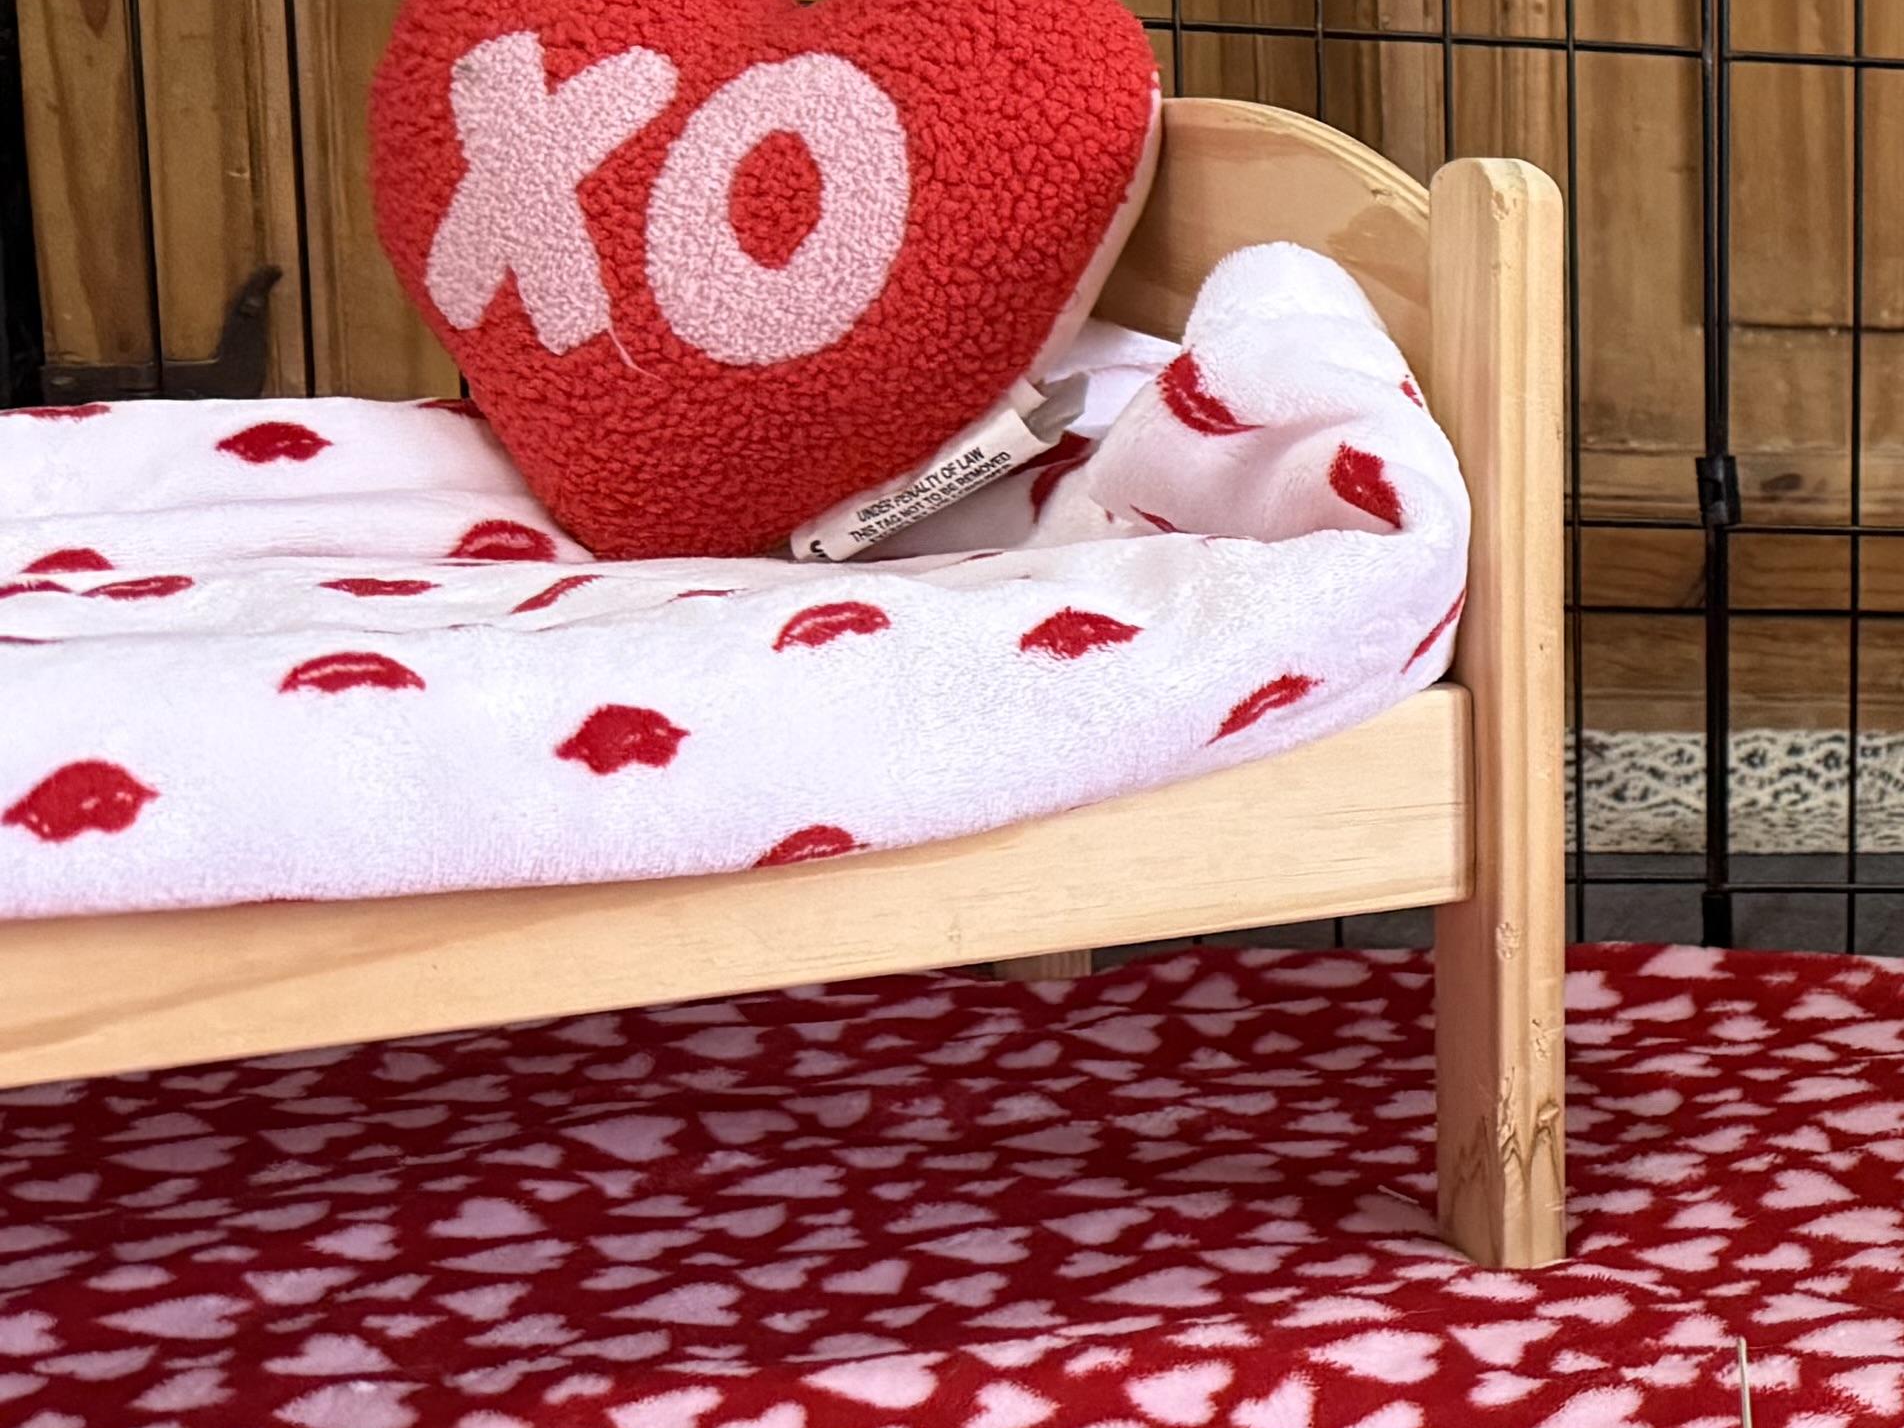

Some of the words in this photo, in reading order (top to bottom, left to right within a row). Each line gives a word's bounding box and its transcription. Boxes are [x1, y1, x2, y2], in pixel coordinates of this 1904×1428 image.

[425, 31, 912, 368] XO
[849, 523, 877, 543] THIS
[877, 511, 901, 531] TAG
[900, 498, 927, 519] NOT
[924, 491, 942, 506] TO
[941, 481, 958, 496] BE
[956, 450, 1012, 487] REMOVED
[855, 497, 895, 523] UNDER
[893, 473, 944, 507] PENALTY
[940, 462, 958, 479] OF
[955, 446, 985, 471] LAW
